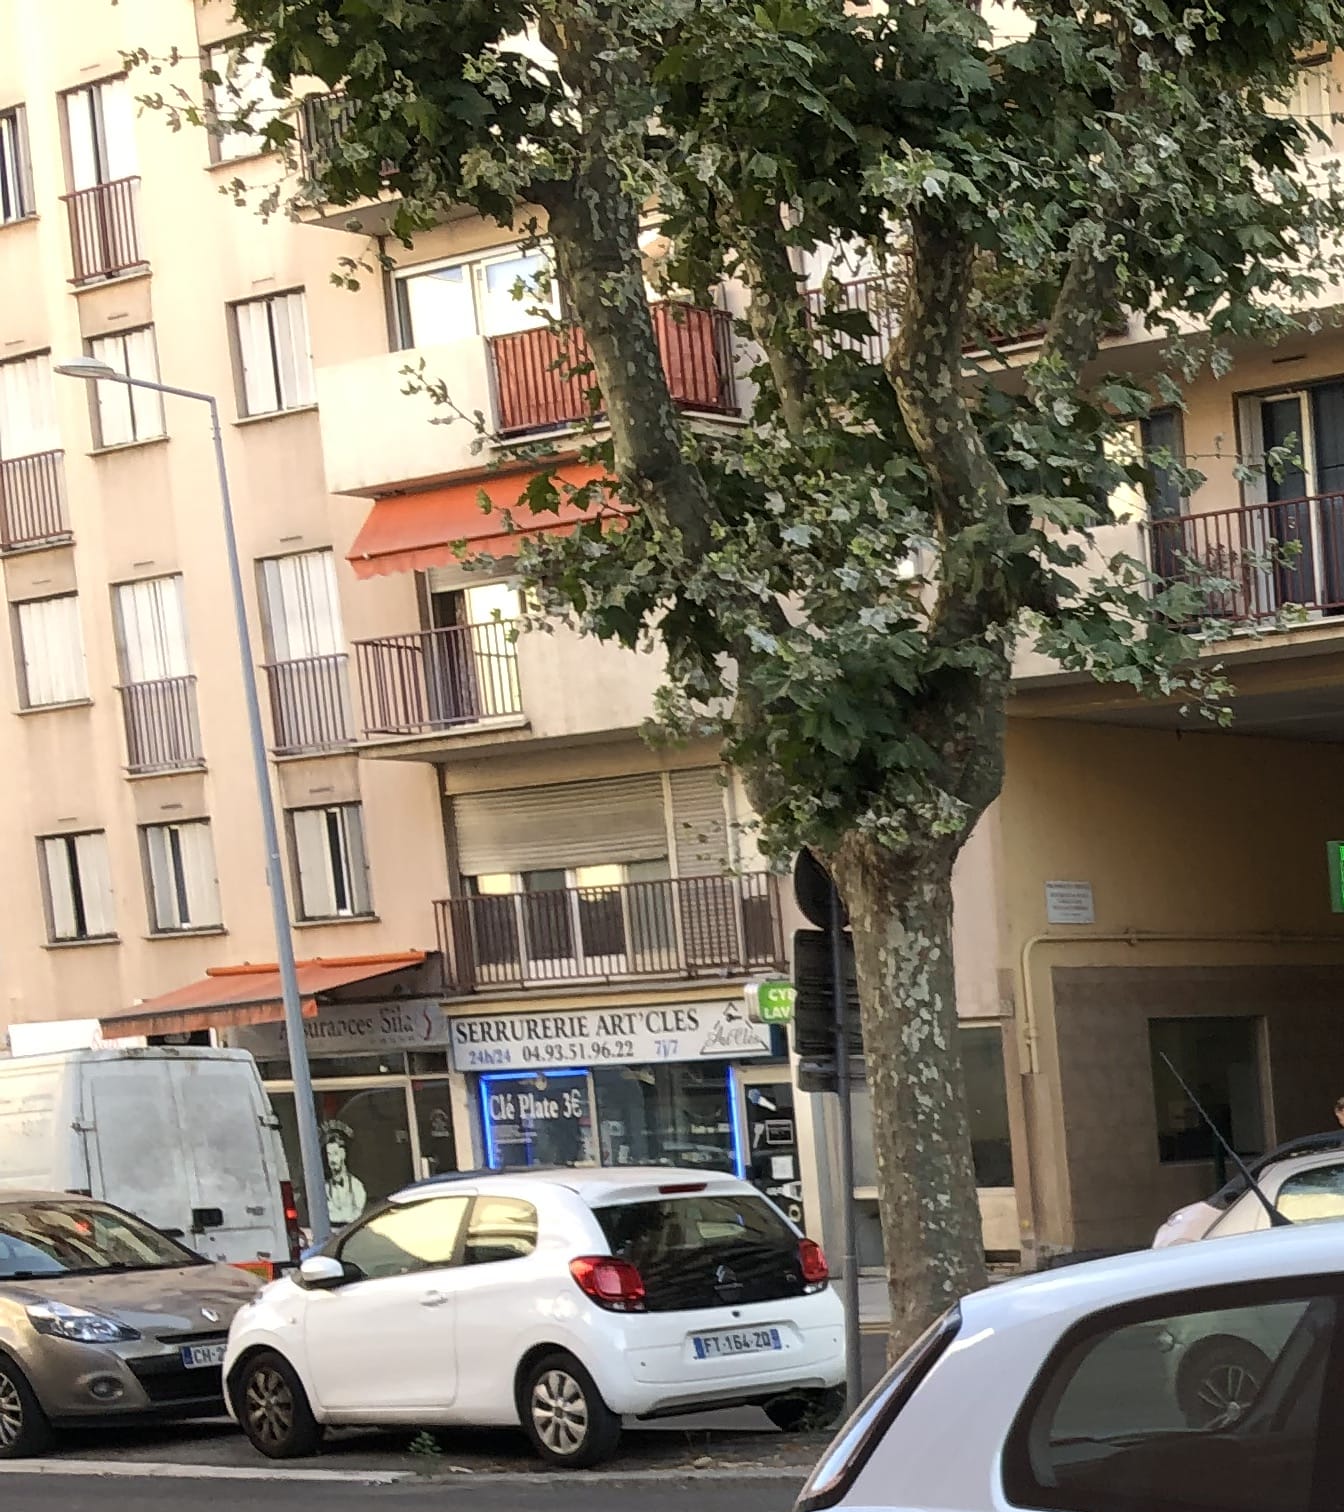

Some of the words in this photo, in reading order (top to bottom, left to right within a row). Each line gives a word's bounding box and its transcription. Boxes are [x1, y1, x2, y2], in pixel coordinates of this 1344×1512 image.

[455, 1015, 590, 1044] SERRURERIE
[596, 1008, 700, 1037] ART'CLES
[522, 1039, 634, 1063] 04.93.51.96.22
[489, 1093, 515, 1121] Clé
[517, 1092, 559, 1120] Plate
[562, 1088, 583, 1119] 3€
